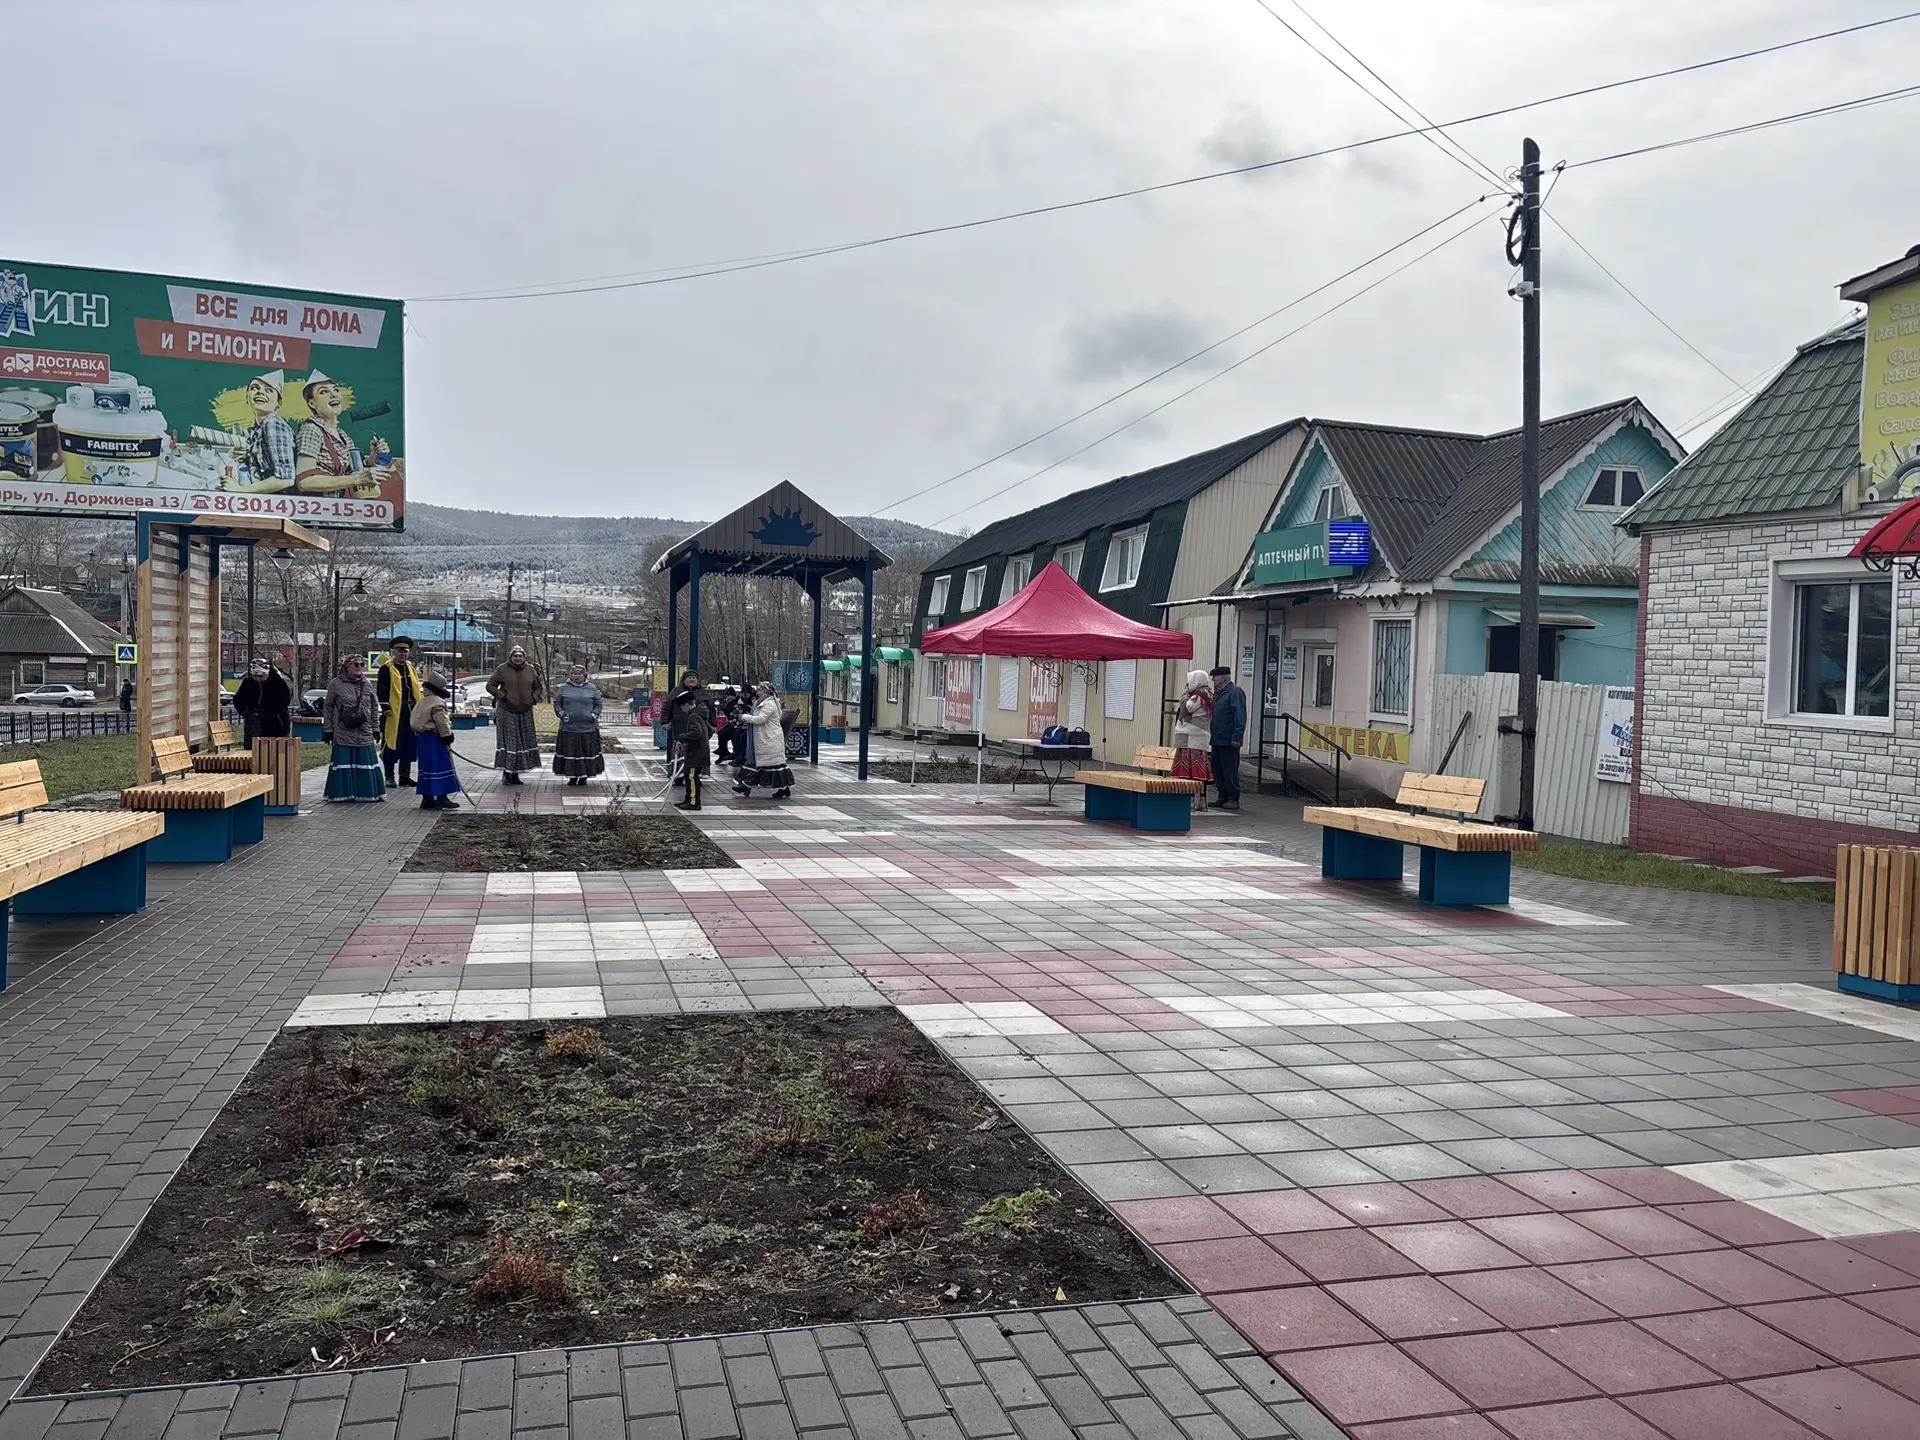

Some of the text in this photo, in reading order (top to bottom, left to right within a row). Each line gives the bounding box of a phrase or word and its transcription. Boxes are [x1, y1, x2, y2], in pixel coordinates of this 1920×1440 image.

[196, 293, 362, 334] ВСЕ для ДОМА
[36, 355, 105, 371] ДОСТАВКА
[161, 330, 287, 363] и РЕМОНТА
[87, 440, 139, 451] FARBITEX
[33, 492, 58, 505] ул.
[64, 491, 154, 507] Доржиева
[214, 496, 387, 519] 8(3014)32-15-30
[1258, 544, 1310, 566] АПТЕЧНЫЙ
[947, 659, 971, 698] СДАМ
[1030, 661, 1057, 710] СДАМ
[1308, 724, 1398, 761] АПТЕКА
